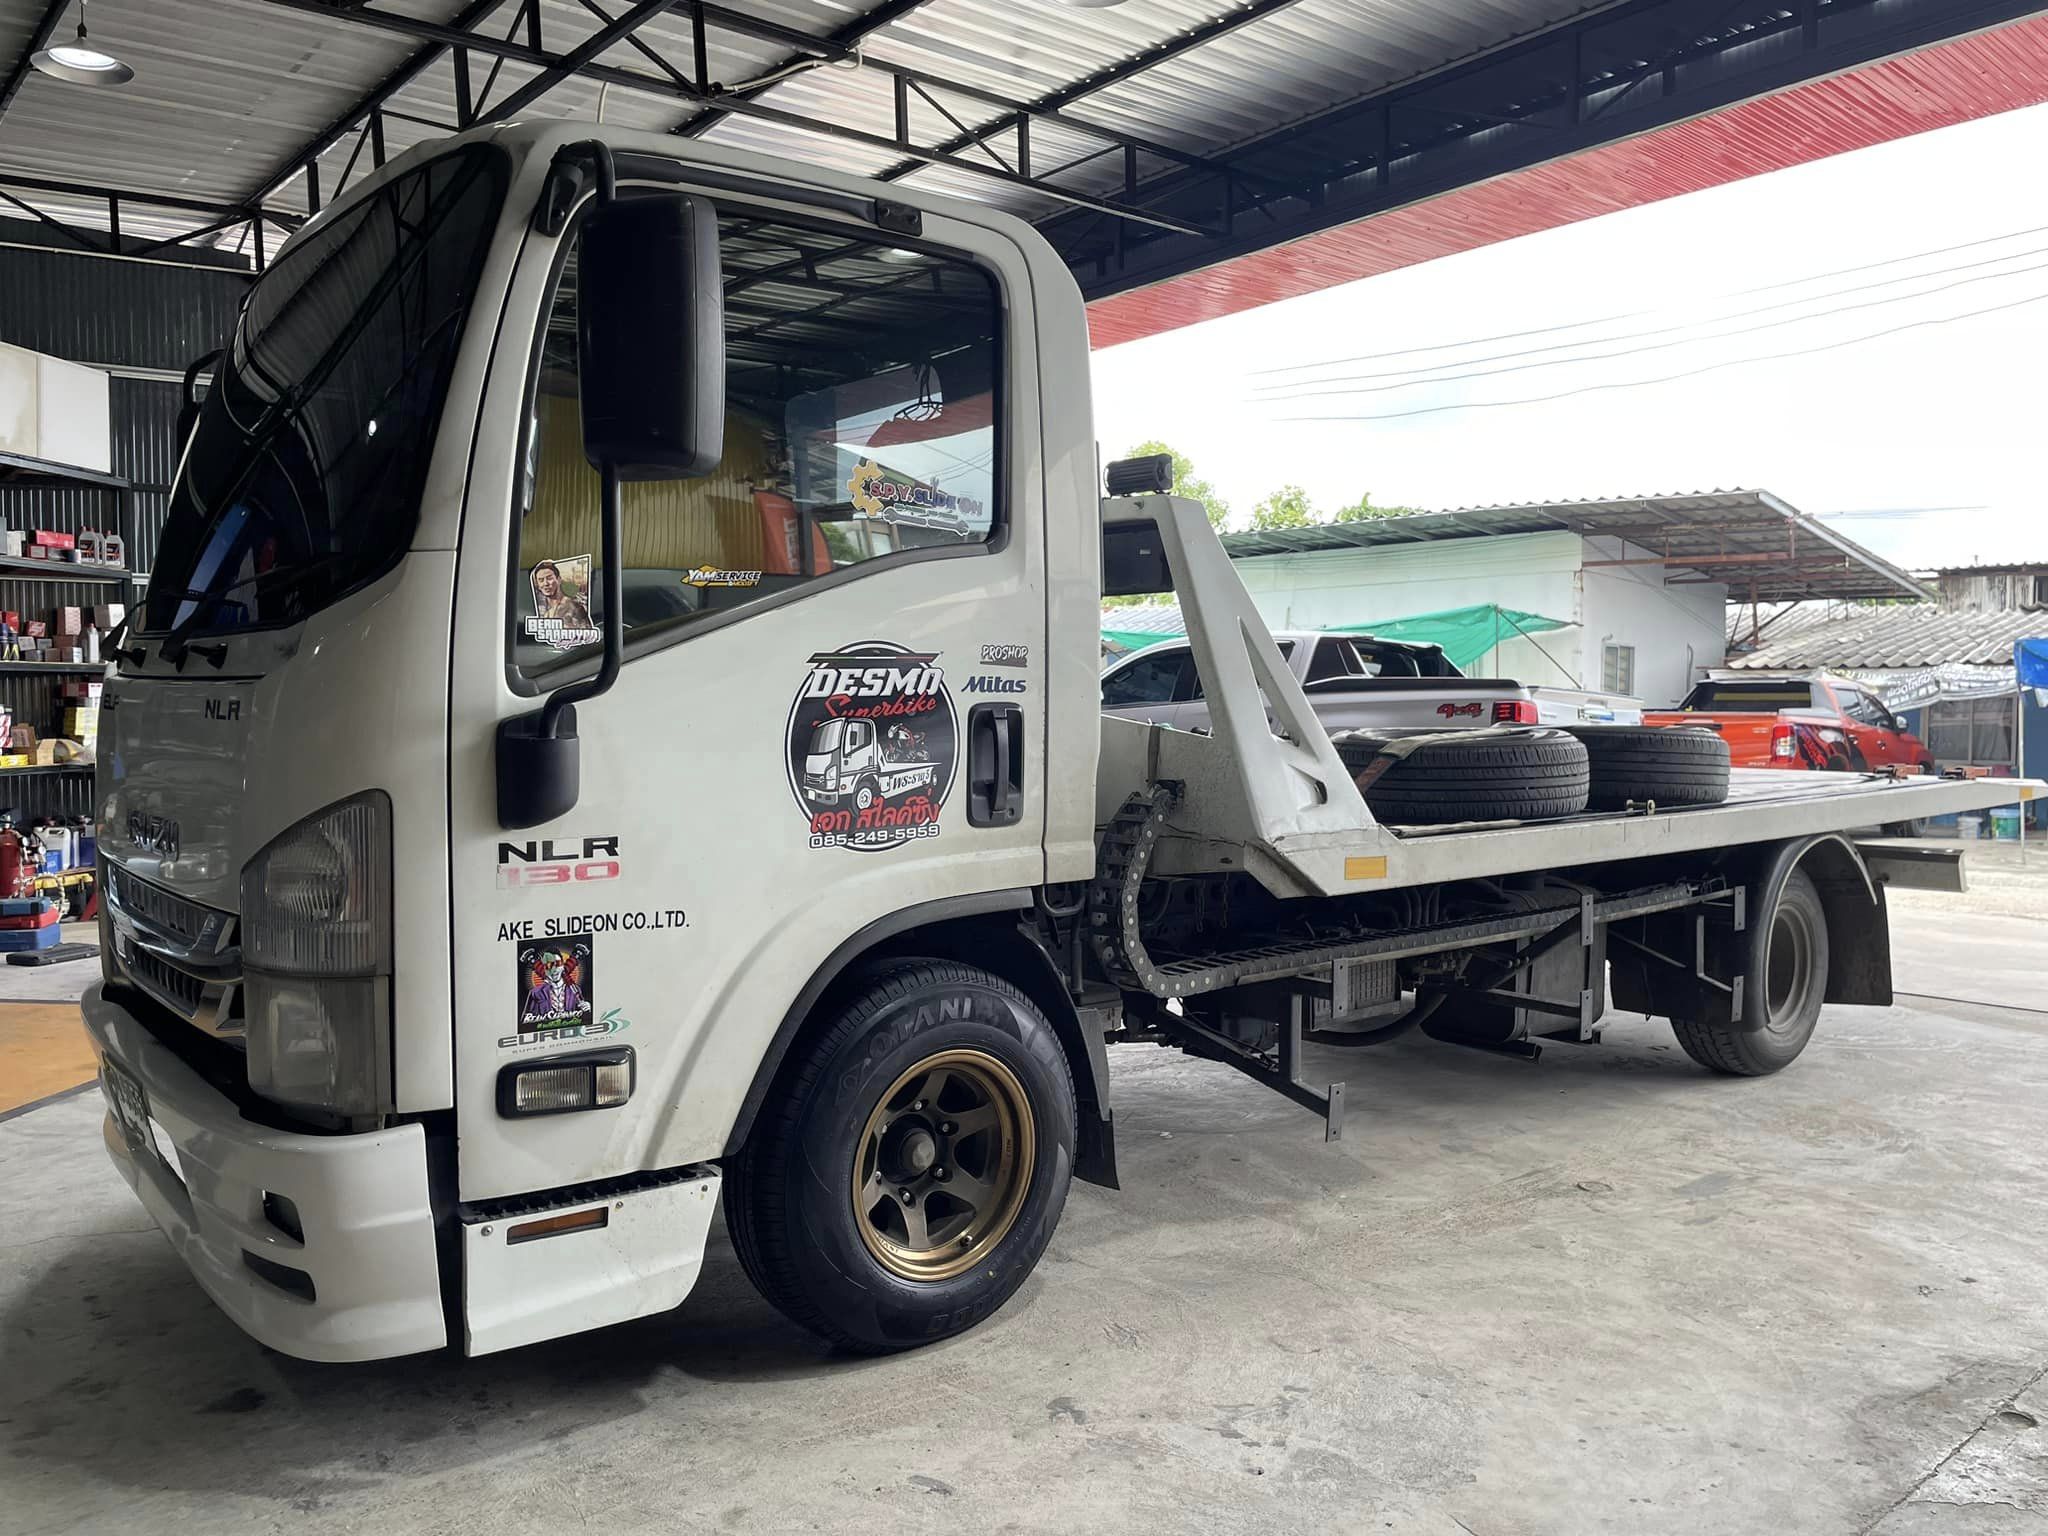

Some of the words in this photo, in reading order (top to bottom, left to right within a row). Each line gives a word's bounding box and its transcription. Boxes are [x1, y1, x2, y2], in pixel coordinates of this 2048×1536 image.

[981, 644, 1029, 661] PROSHOP
[803, 667, 944, 698] DESMO
[961, 676, 1027, 693] Mitas
[204, 698, 241, 720] NLR
[1436, 702, 1485, 719] 4x4
[811, 808, 852, 833] เอก
[810, 825, 940, 848] 085-249-5959
[498, 836, 620, 864] NLR
[497, 920, 534, 942] AKE
[544, 913, 618, 936] SLIDEON
